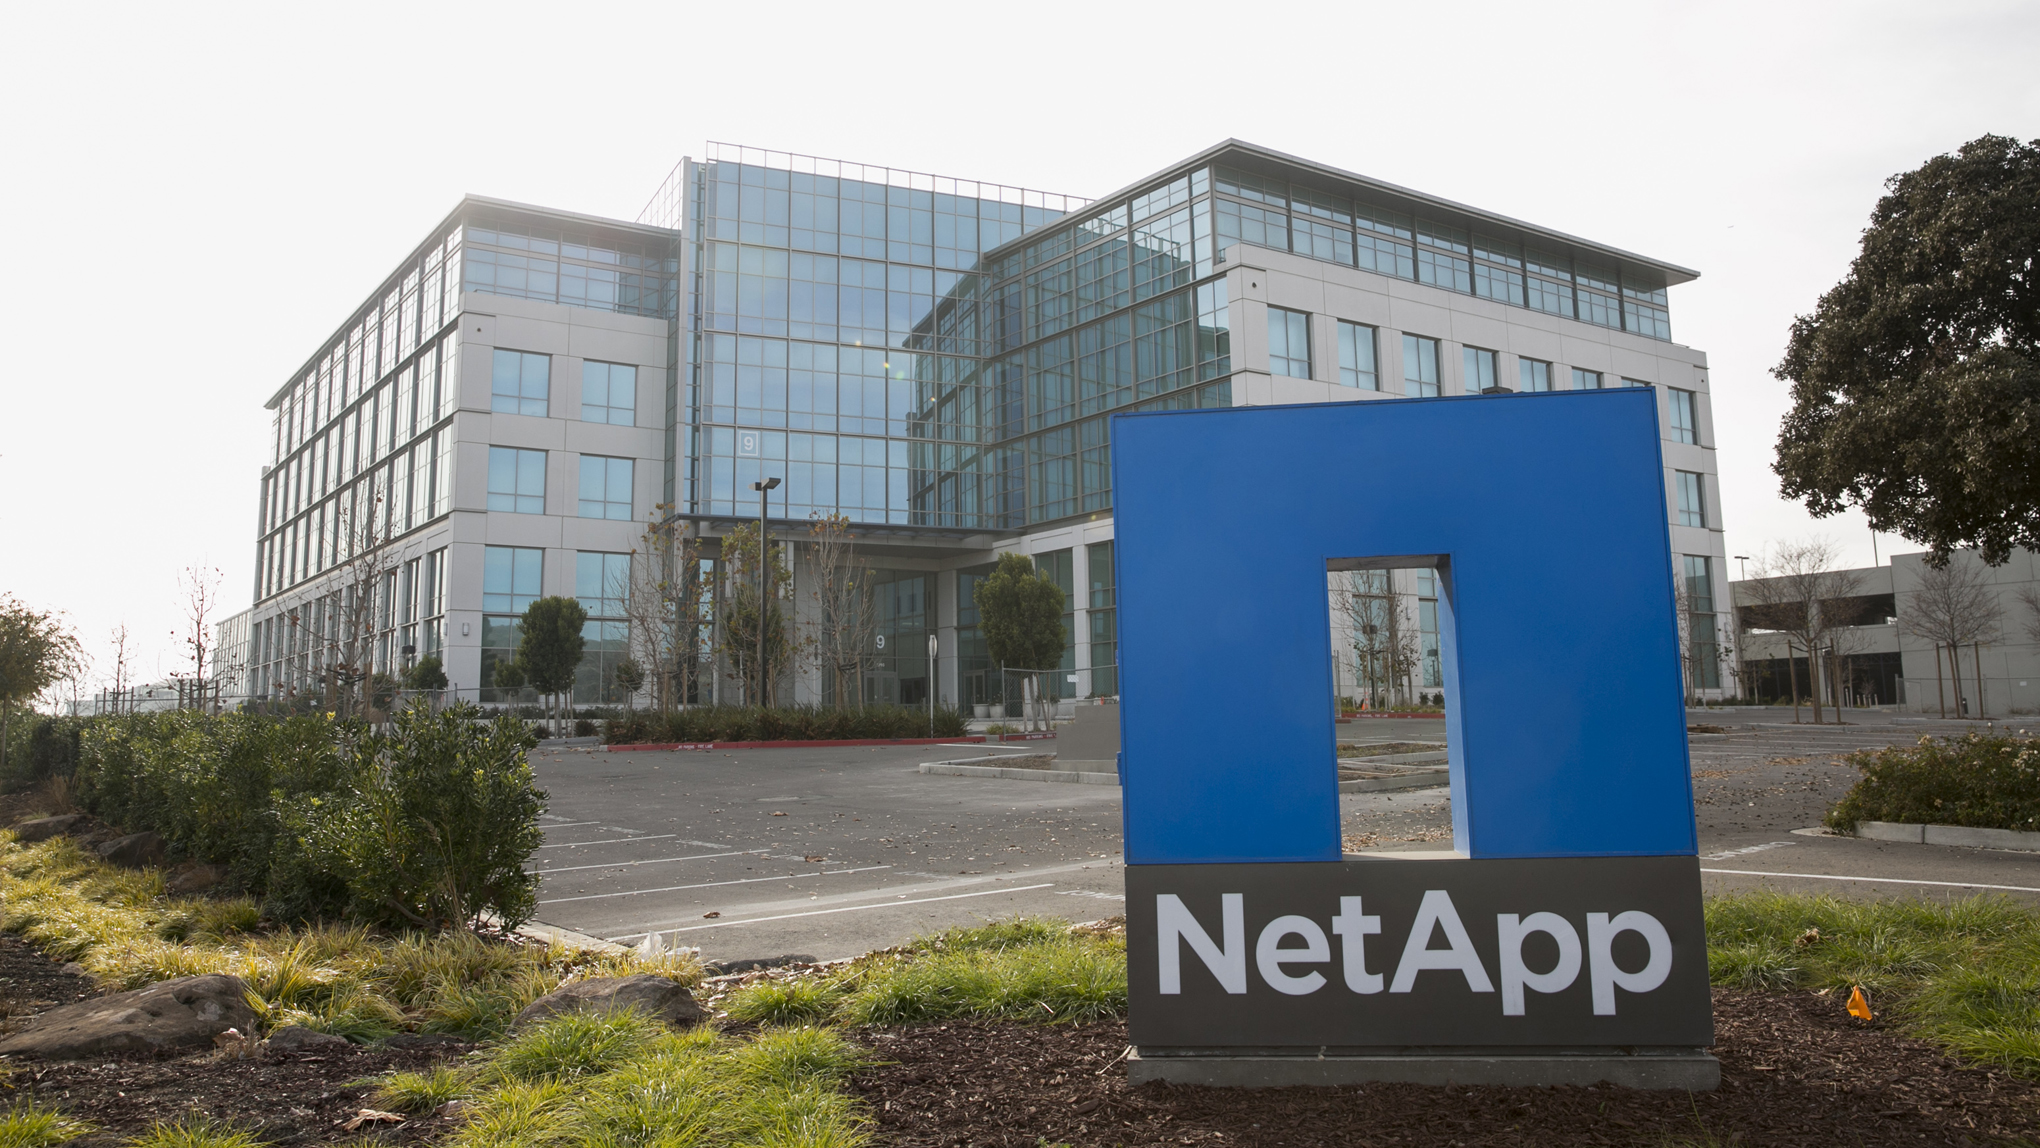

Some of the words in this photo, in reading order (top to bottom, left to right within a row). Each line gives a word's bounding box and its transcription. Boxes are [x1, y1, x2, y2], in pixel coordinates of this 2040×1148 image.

[743, 436, 754, 451] 9
[876, 634, 885, 649] 9
[1156, 889, 1673, 1016] NetApp
